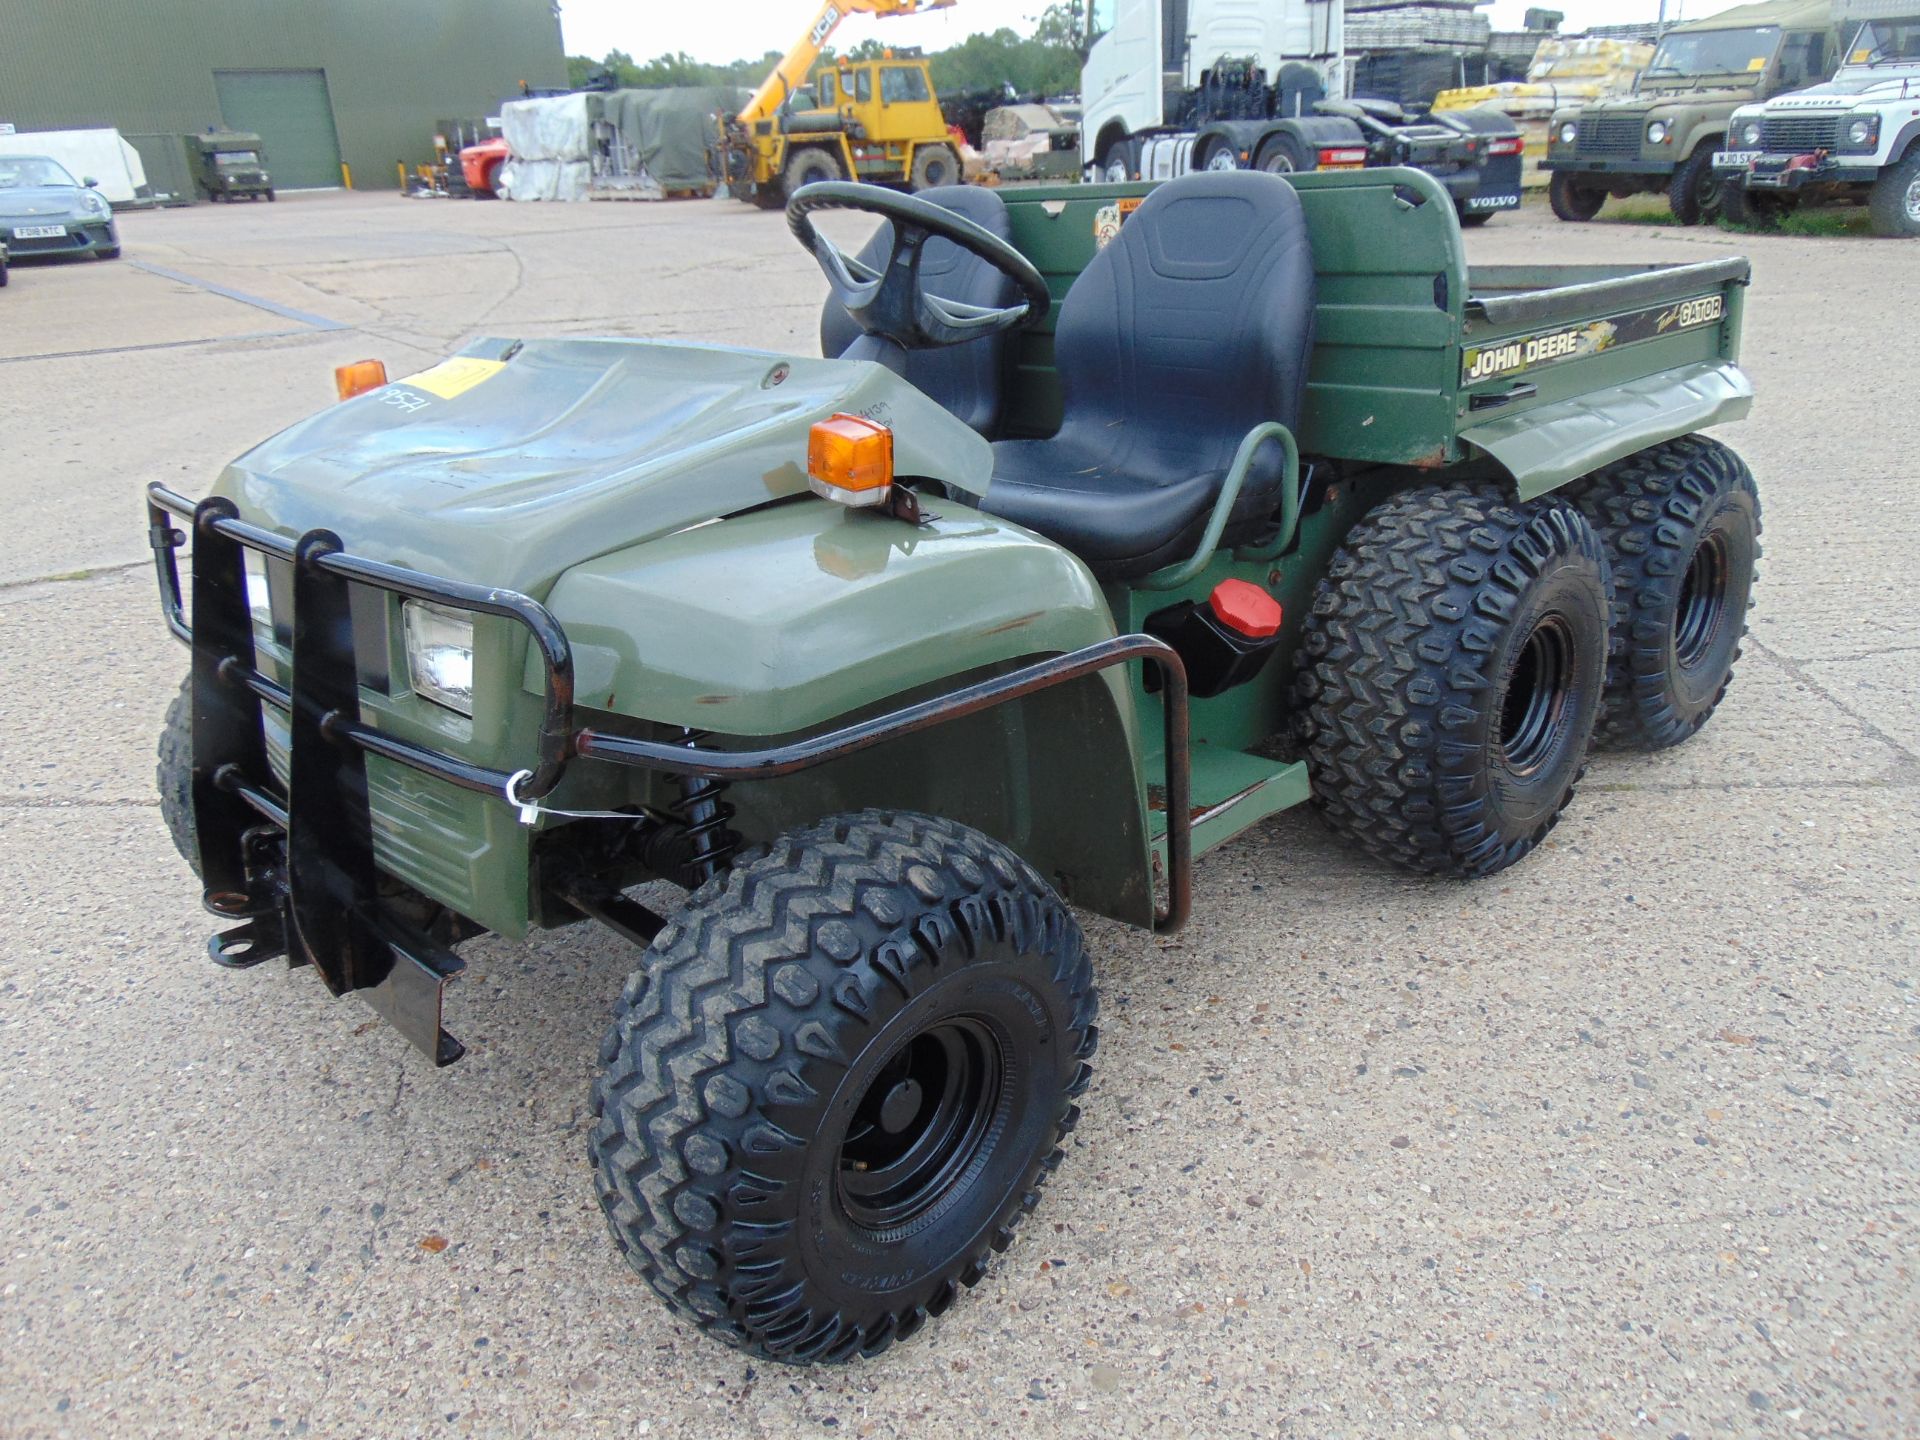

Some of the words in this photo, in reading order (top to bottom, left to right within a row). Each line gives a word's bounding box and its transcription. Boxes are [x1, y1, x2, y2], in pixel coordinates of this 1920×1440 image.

[811, 7, 838, 46] JCB
[1470, 195, 1518, 208] VOLVO
[1471, 344, 1521, 377] JOHN
[1526, 331, 1578, 363] DEERE
[1680, 295, 1722, 326] GATOR
